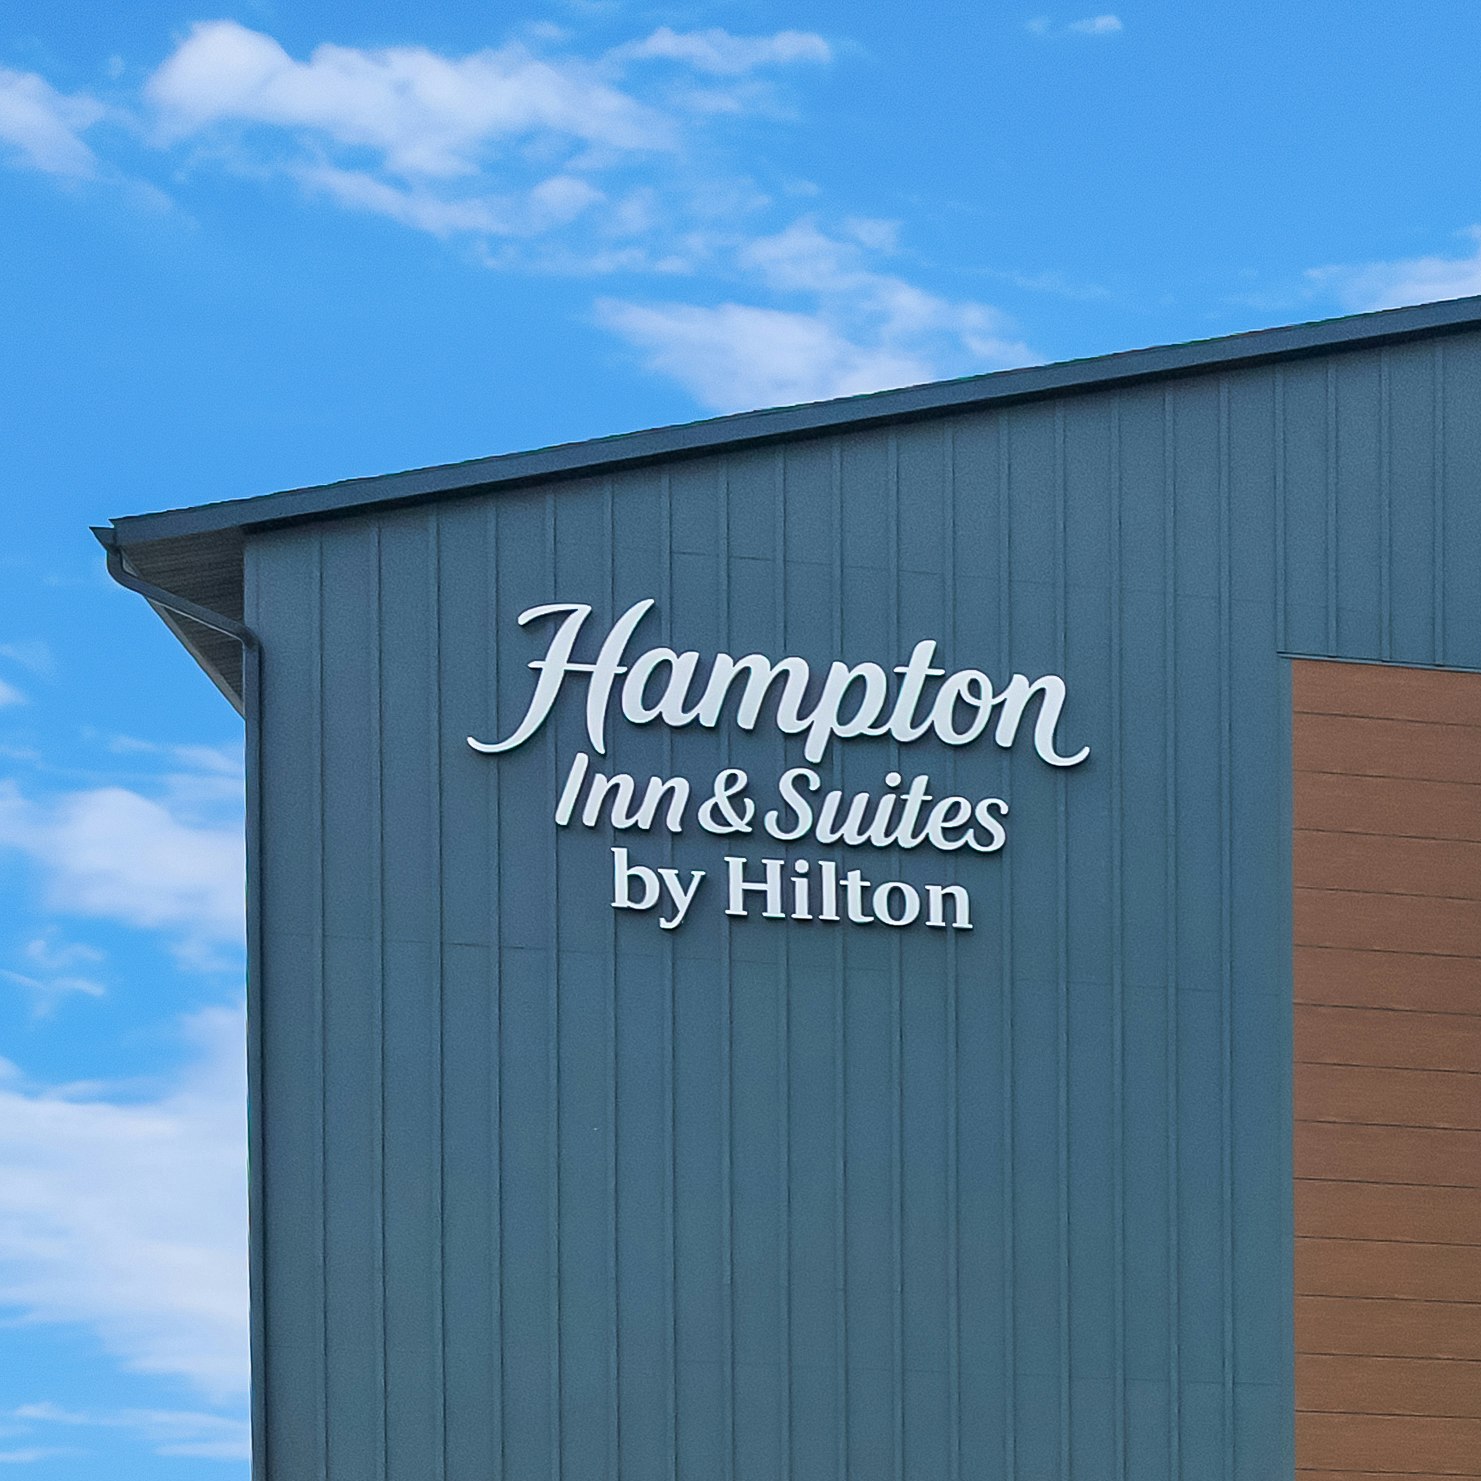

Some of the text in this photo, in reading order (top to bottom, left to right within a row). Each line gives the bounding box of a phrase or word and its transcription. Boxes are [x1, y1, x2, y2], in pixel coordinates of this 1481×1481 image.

[466, 598, 1090, 767] Hampton
[555, 752, 1009, 852] Inn & Suites
[610, 847, 973, 929] by Hilton
